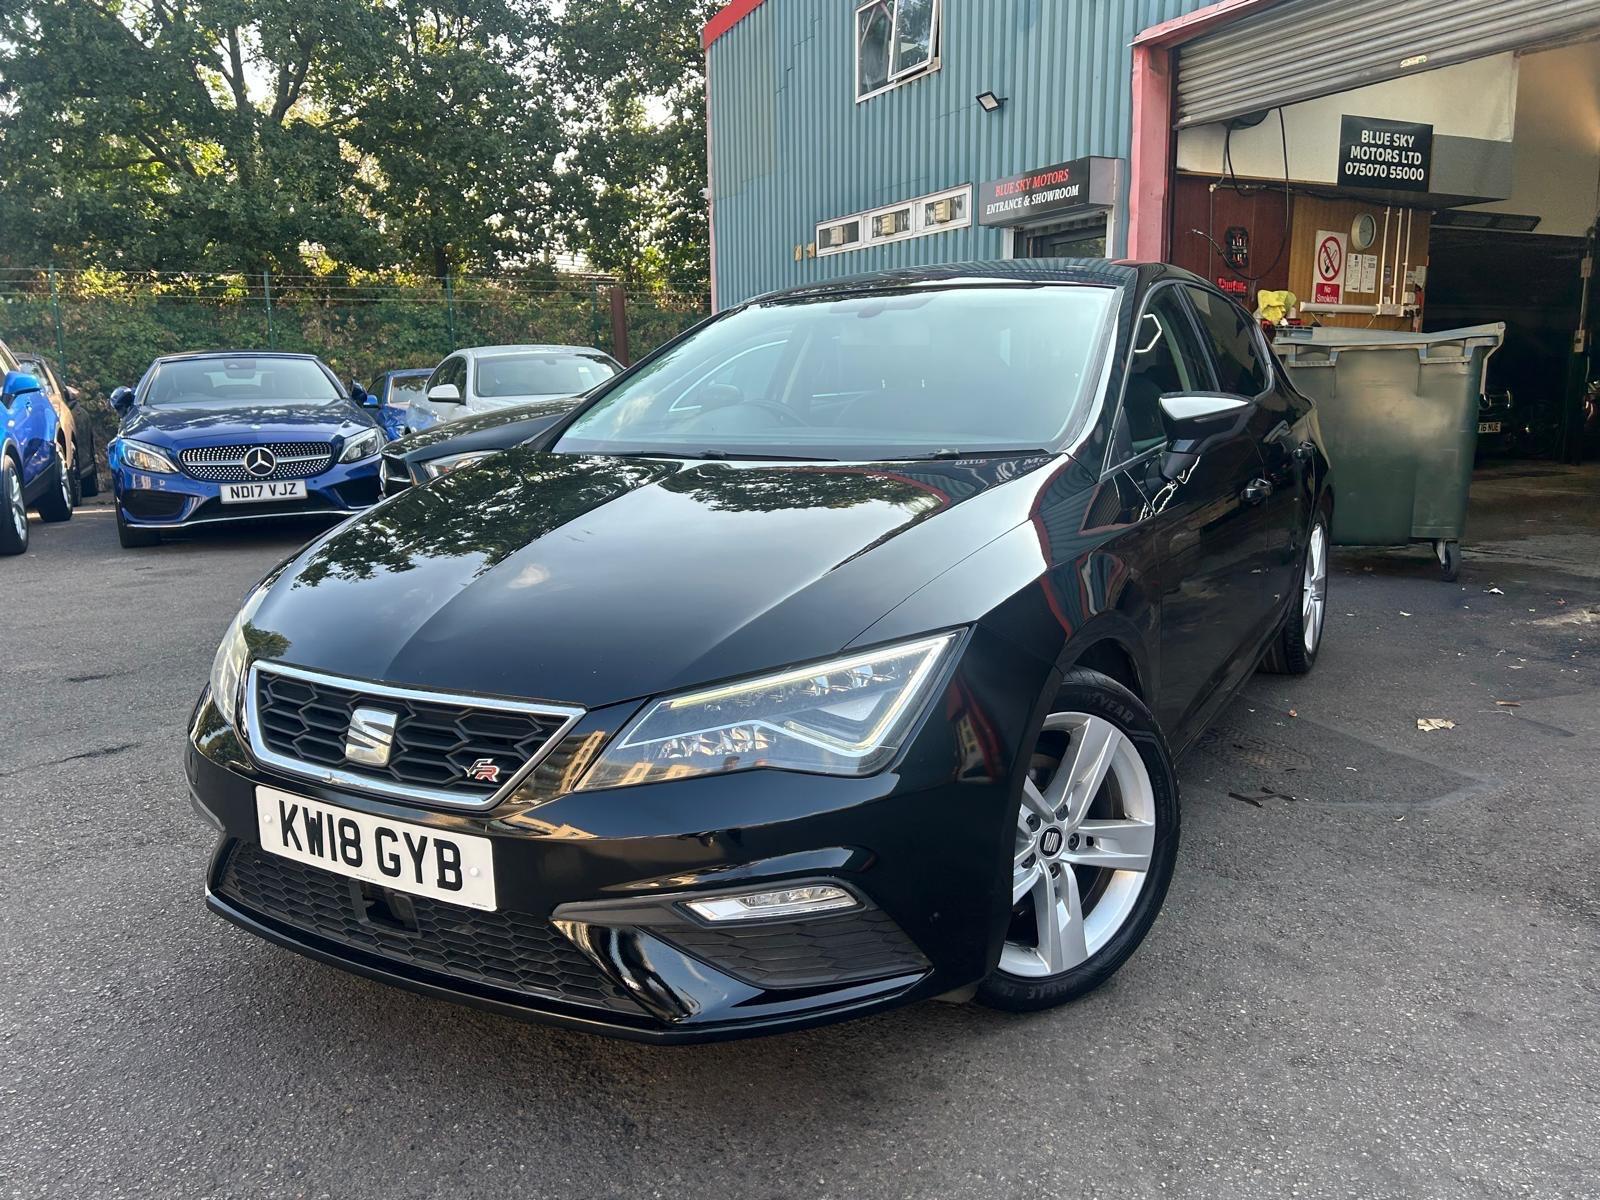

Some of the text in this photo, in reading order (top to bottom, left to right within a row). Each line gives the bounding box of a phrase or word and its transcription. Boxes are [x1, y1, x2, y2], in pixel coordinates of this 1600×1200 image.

[1361, 129, 1415, 148] BLUE SKY
[1350, 145, 1422, 165] MOTORS LTD
[1345, 161, 1425, 181] 075070 55000
[995, 168, 1070, 197] BLUE SKY MOTORS
[986, 184, 1080, 215] ENTRANCE & SHOWROOM
[1316, 294, 1338, 304] Smoking
[1323, 285, 1331, 294] No
[230, 482, 297, 499] ND17 VJZ
[464, 758, 500, 783] FR
[279, 799, 463, 892] KW18 GYB
